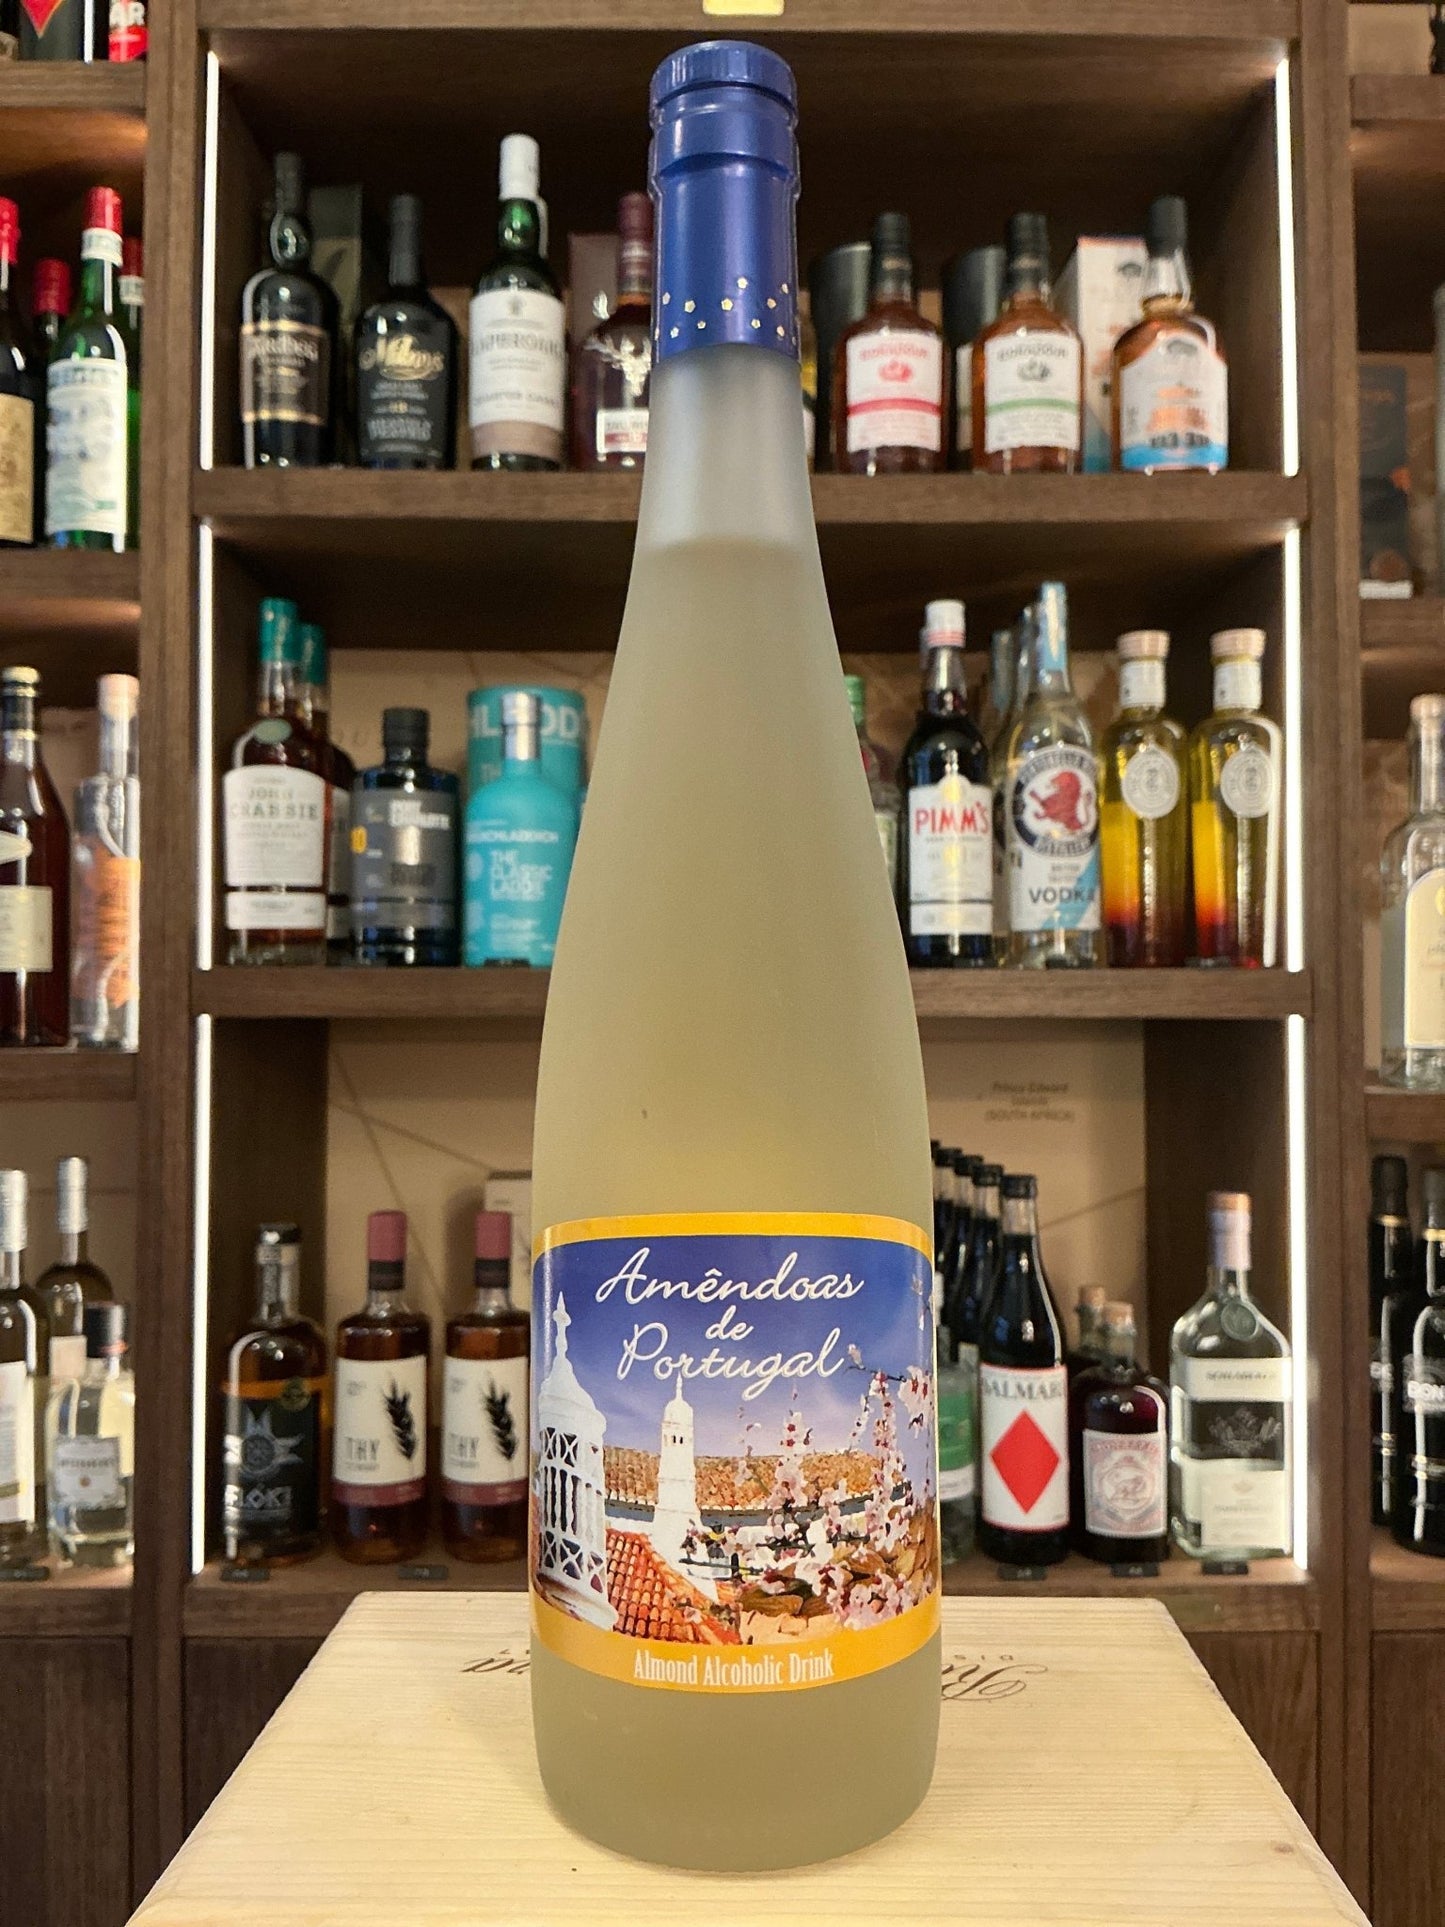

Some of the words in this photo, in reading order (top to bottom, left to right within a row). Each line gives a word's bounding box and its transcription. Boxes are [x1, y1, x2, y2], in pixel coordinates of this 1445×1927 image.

[914, 801, 990, 835] PIMM'S
[1029, 887, 1095, 904] VODKA
[595, 1247, 865, 1304] Amêndoas
[705, 1305, 755, 1341] de
[617, 1322, 845, 1401] Portugal
[634, 1649, 697, 1685] Almond
[703, 1655, 783, 1686] Alcoholic
[789, 1648, 835, 1683] Drink
